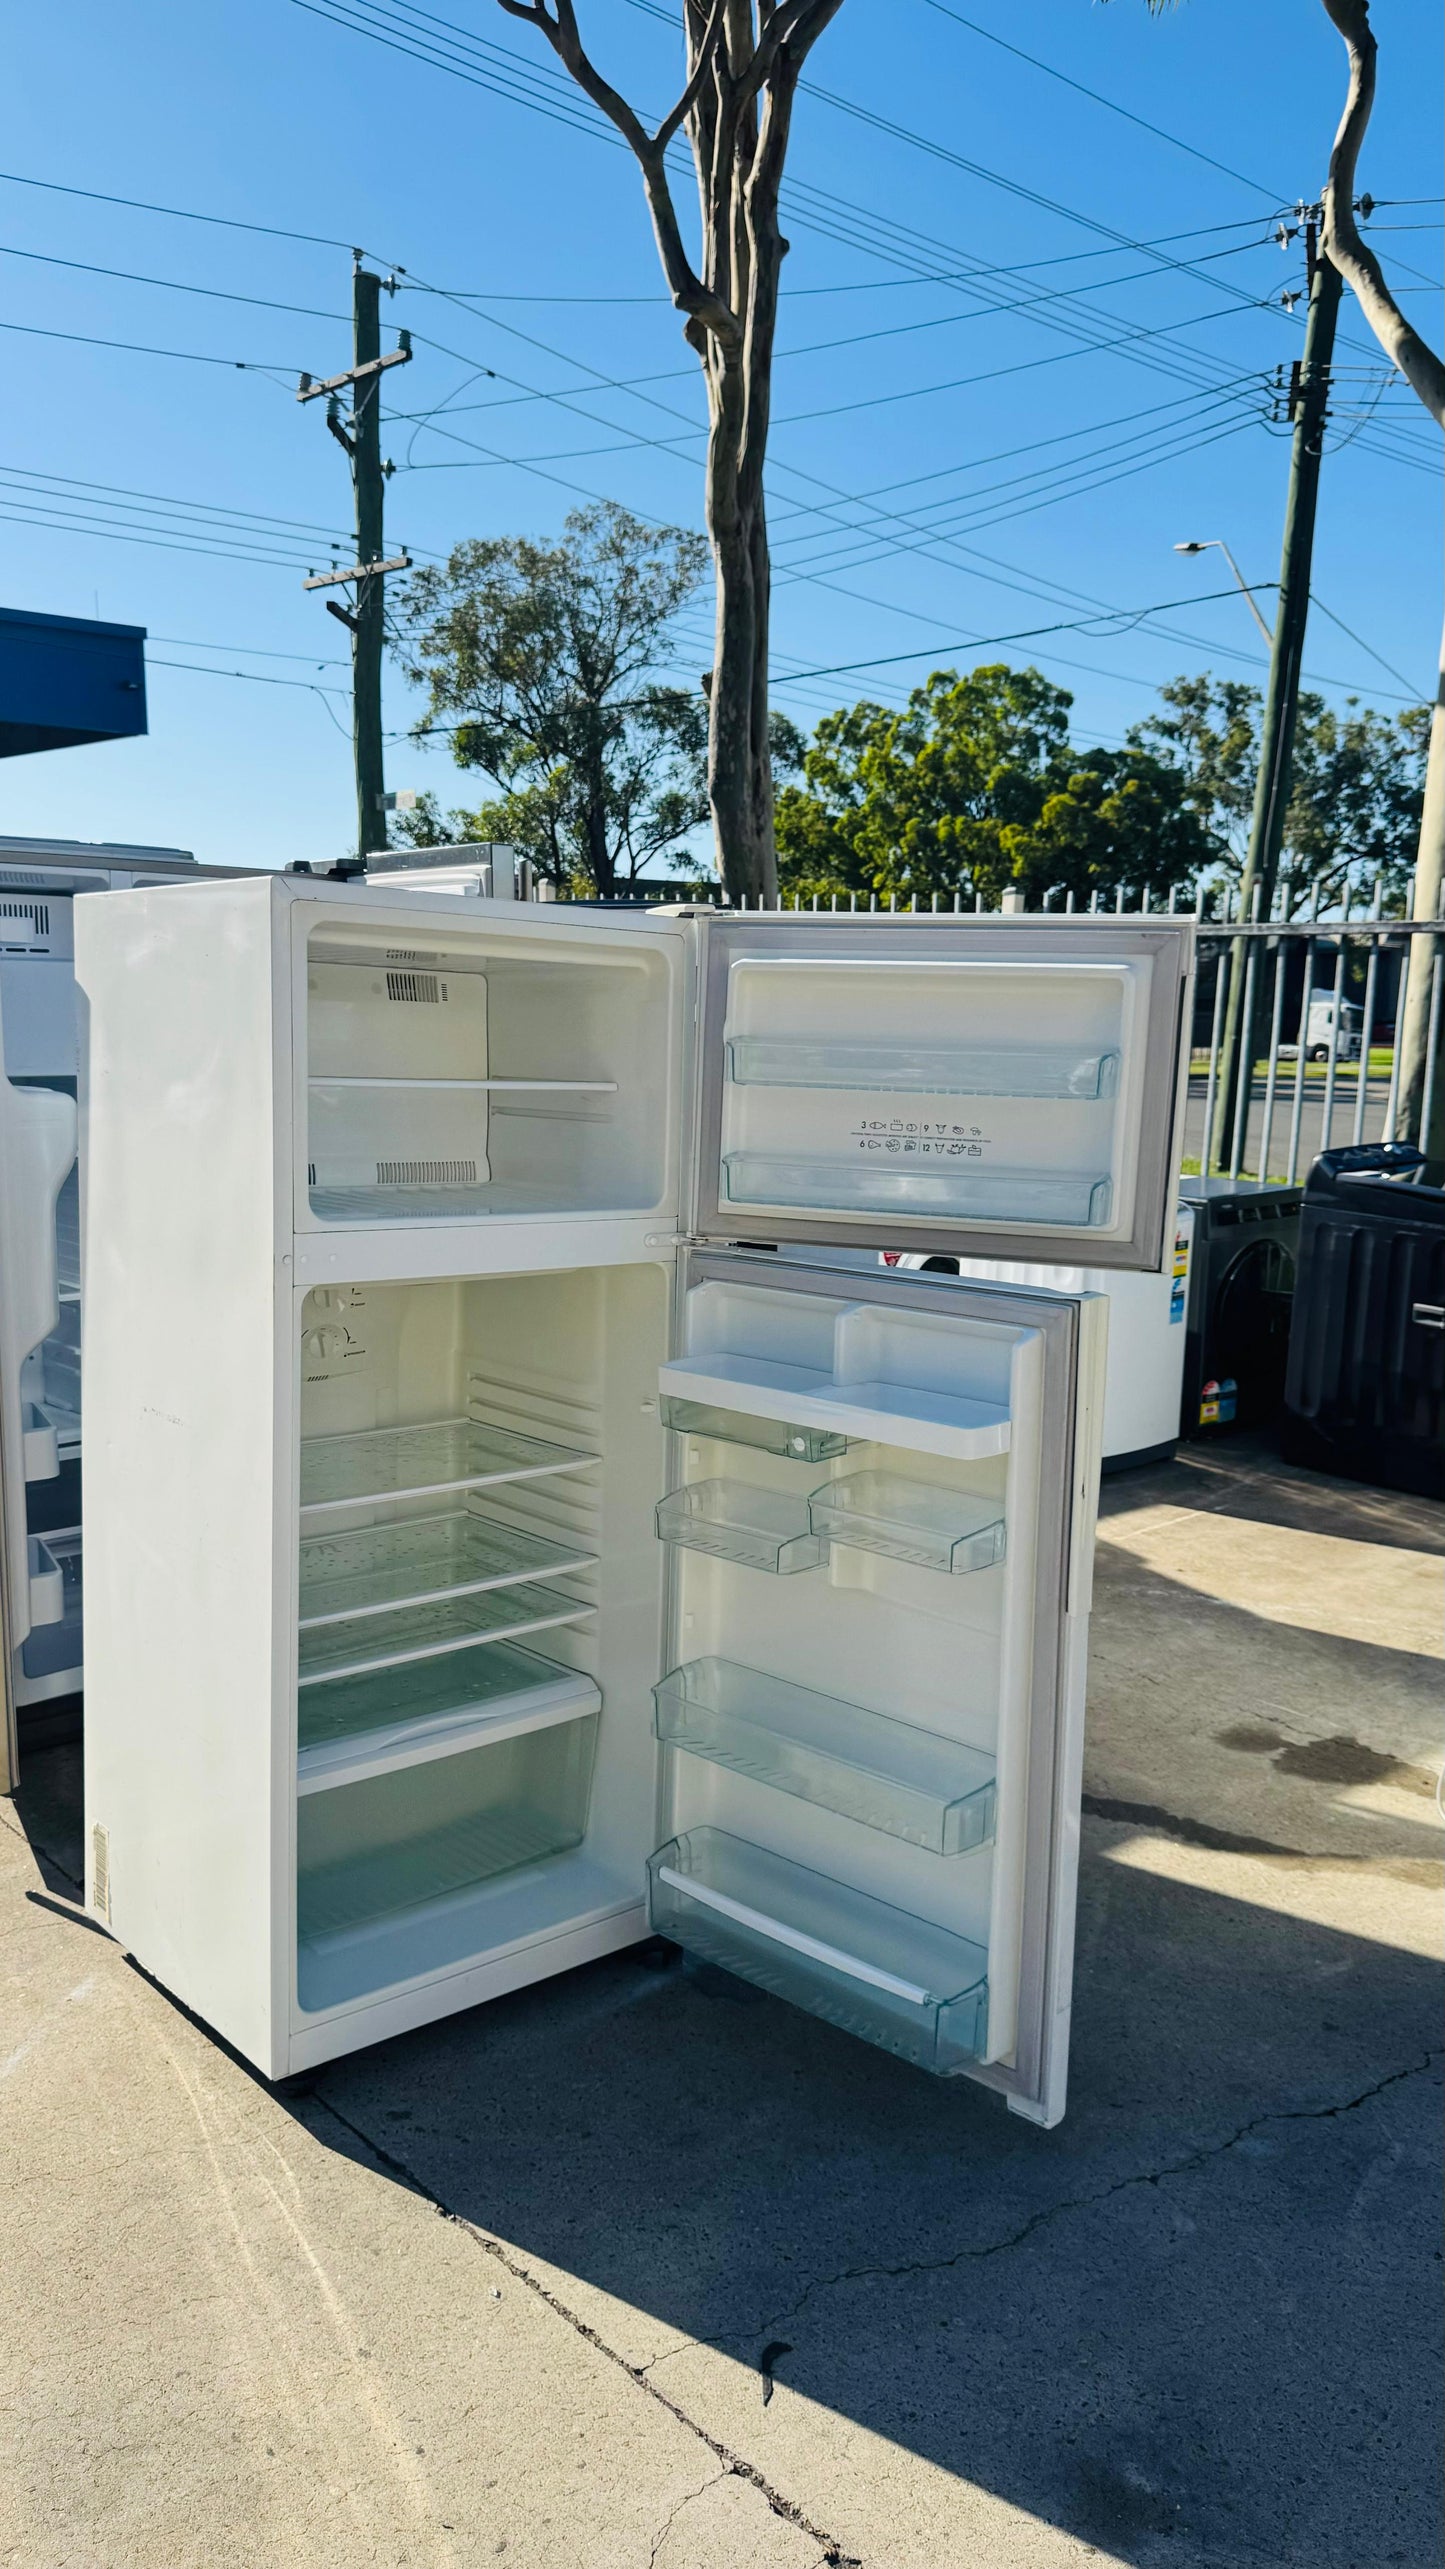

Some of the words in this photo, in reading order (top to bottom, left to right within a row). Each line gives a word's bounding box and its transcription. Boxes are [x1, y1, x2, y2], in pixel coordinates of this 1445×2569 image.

[861, 1121, 866, 1129] 3
[923, 1124, 929, 1133] 9
[860, 1140, 865, 1148] 6
[922, 1143, 930, 1152] 12
